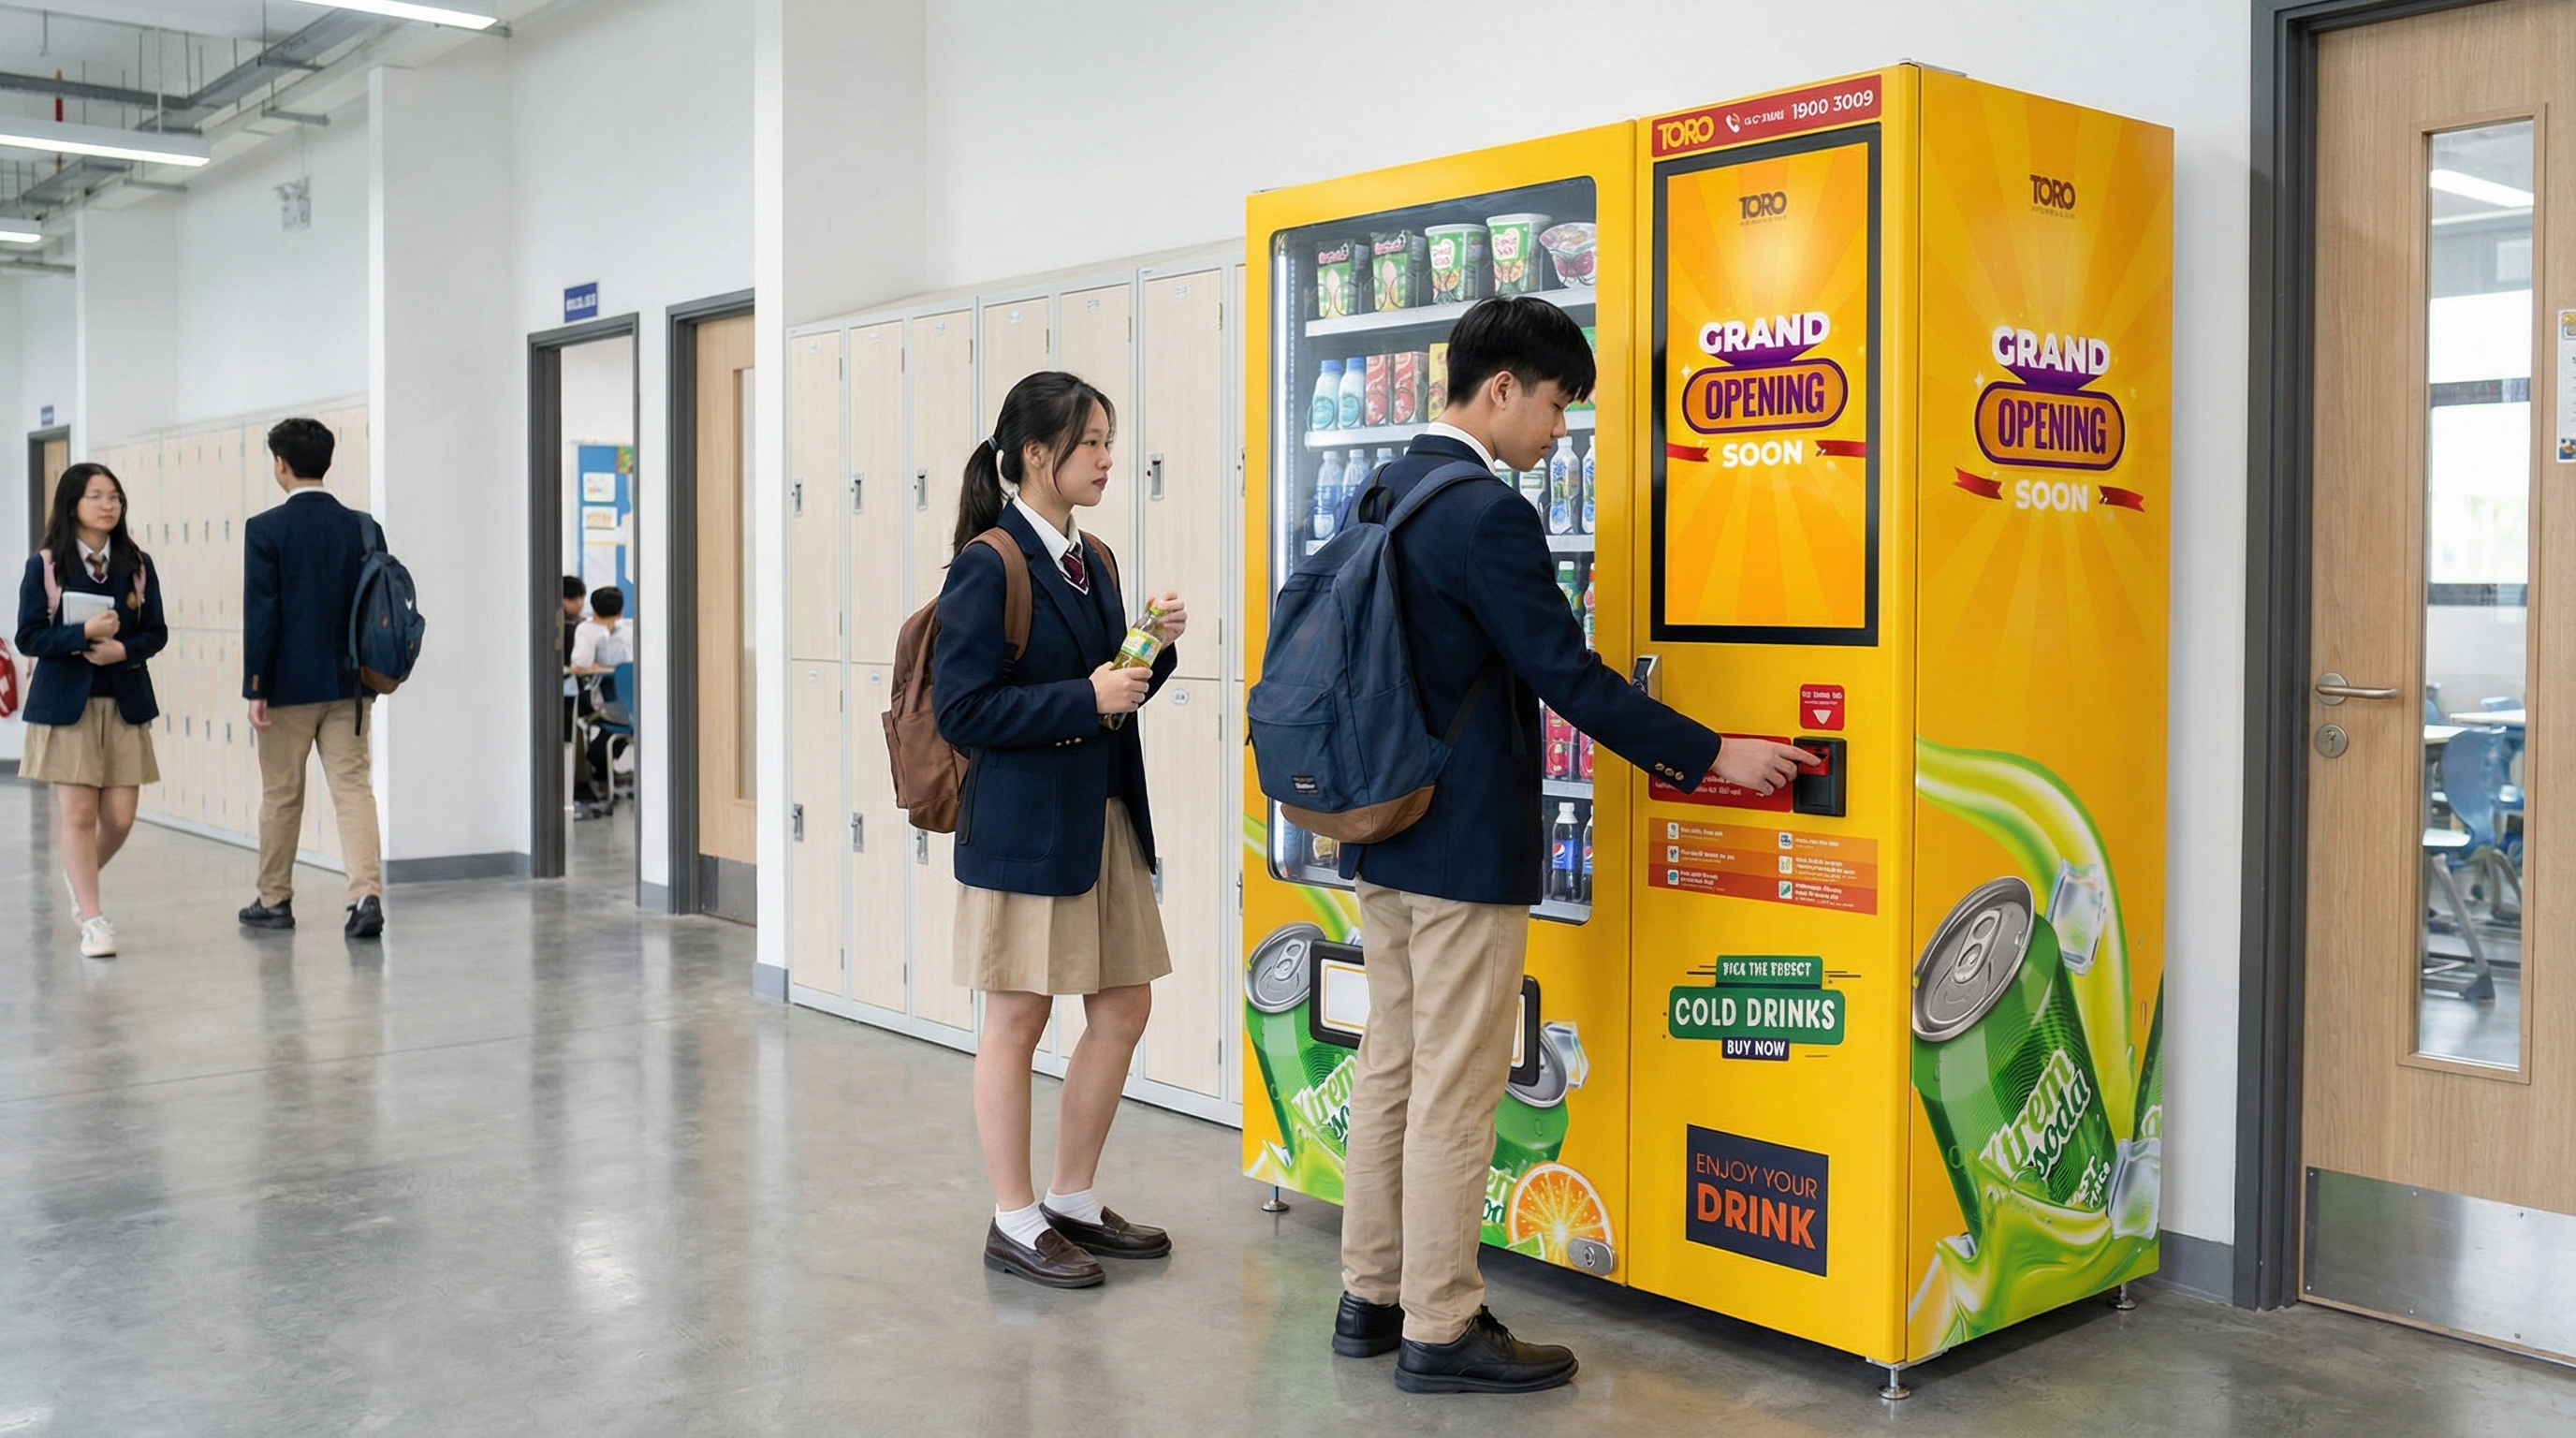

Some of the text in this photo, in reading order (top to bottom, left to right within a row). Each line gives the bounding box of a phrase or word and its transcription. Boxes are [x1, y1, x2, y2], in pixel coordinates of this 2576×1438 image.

[1792, 98, 1829, 120] 1900
[1833, 89, 1873, 111] 3009
[1658, 115, 1714, 150] TORO
[1738, 191, 1787, 219] TORO
[2029, 174, 2075, 210] TORO
[1699, 312, 1830, 354] GRAND
[1992, 325, 2110, 375] GRAND
[1705, 372, 1824, 420] OPENING
[1998, 398, 2107, 455] OPENING
[1721, 439, 1804, 468] SOON
[2014, 479, 2089, 512] SOON
[1676, 997, 1836, 1030] COLD DRINKS
[1727, 1039, 1785, 1057] BUY NOW
[1696, 1152, 1818, 1199] ENJOY YOUR
[1697, 1182, 1816, 1249] DRINK
